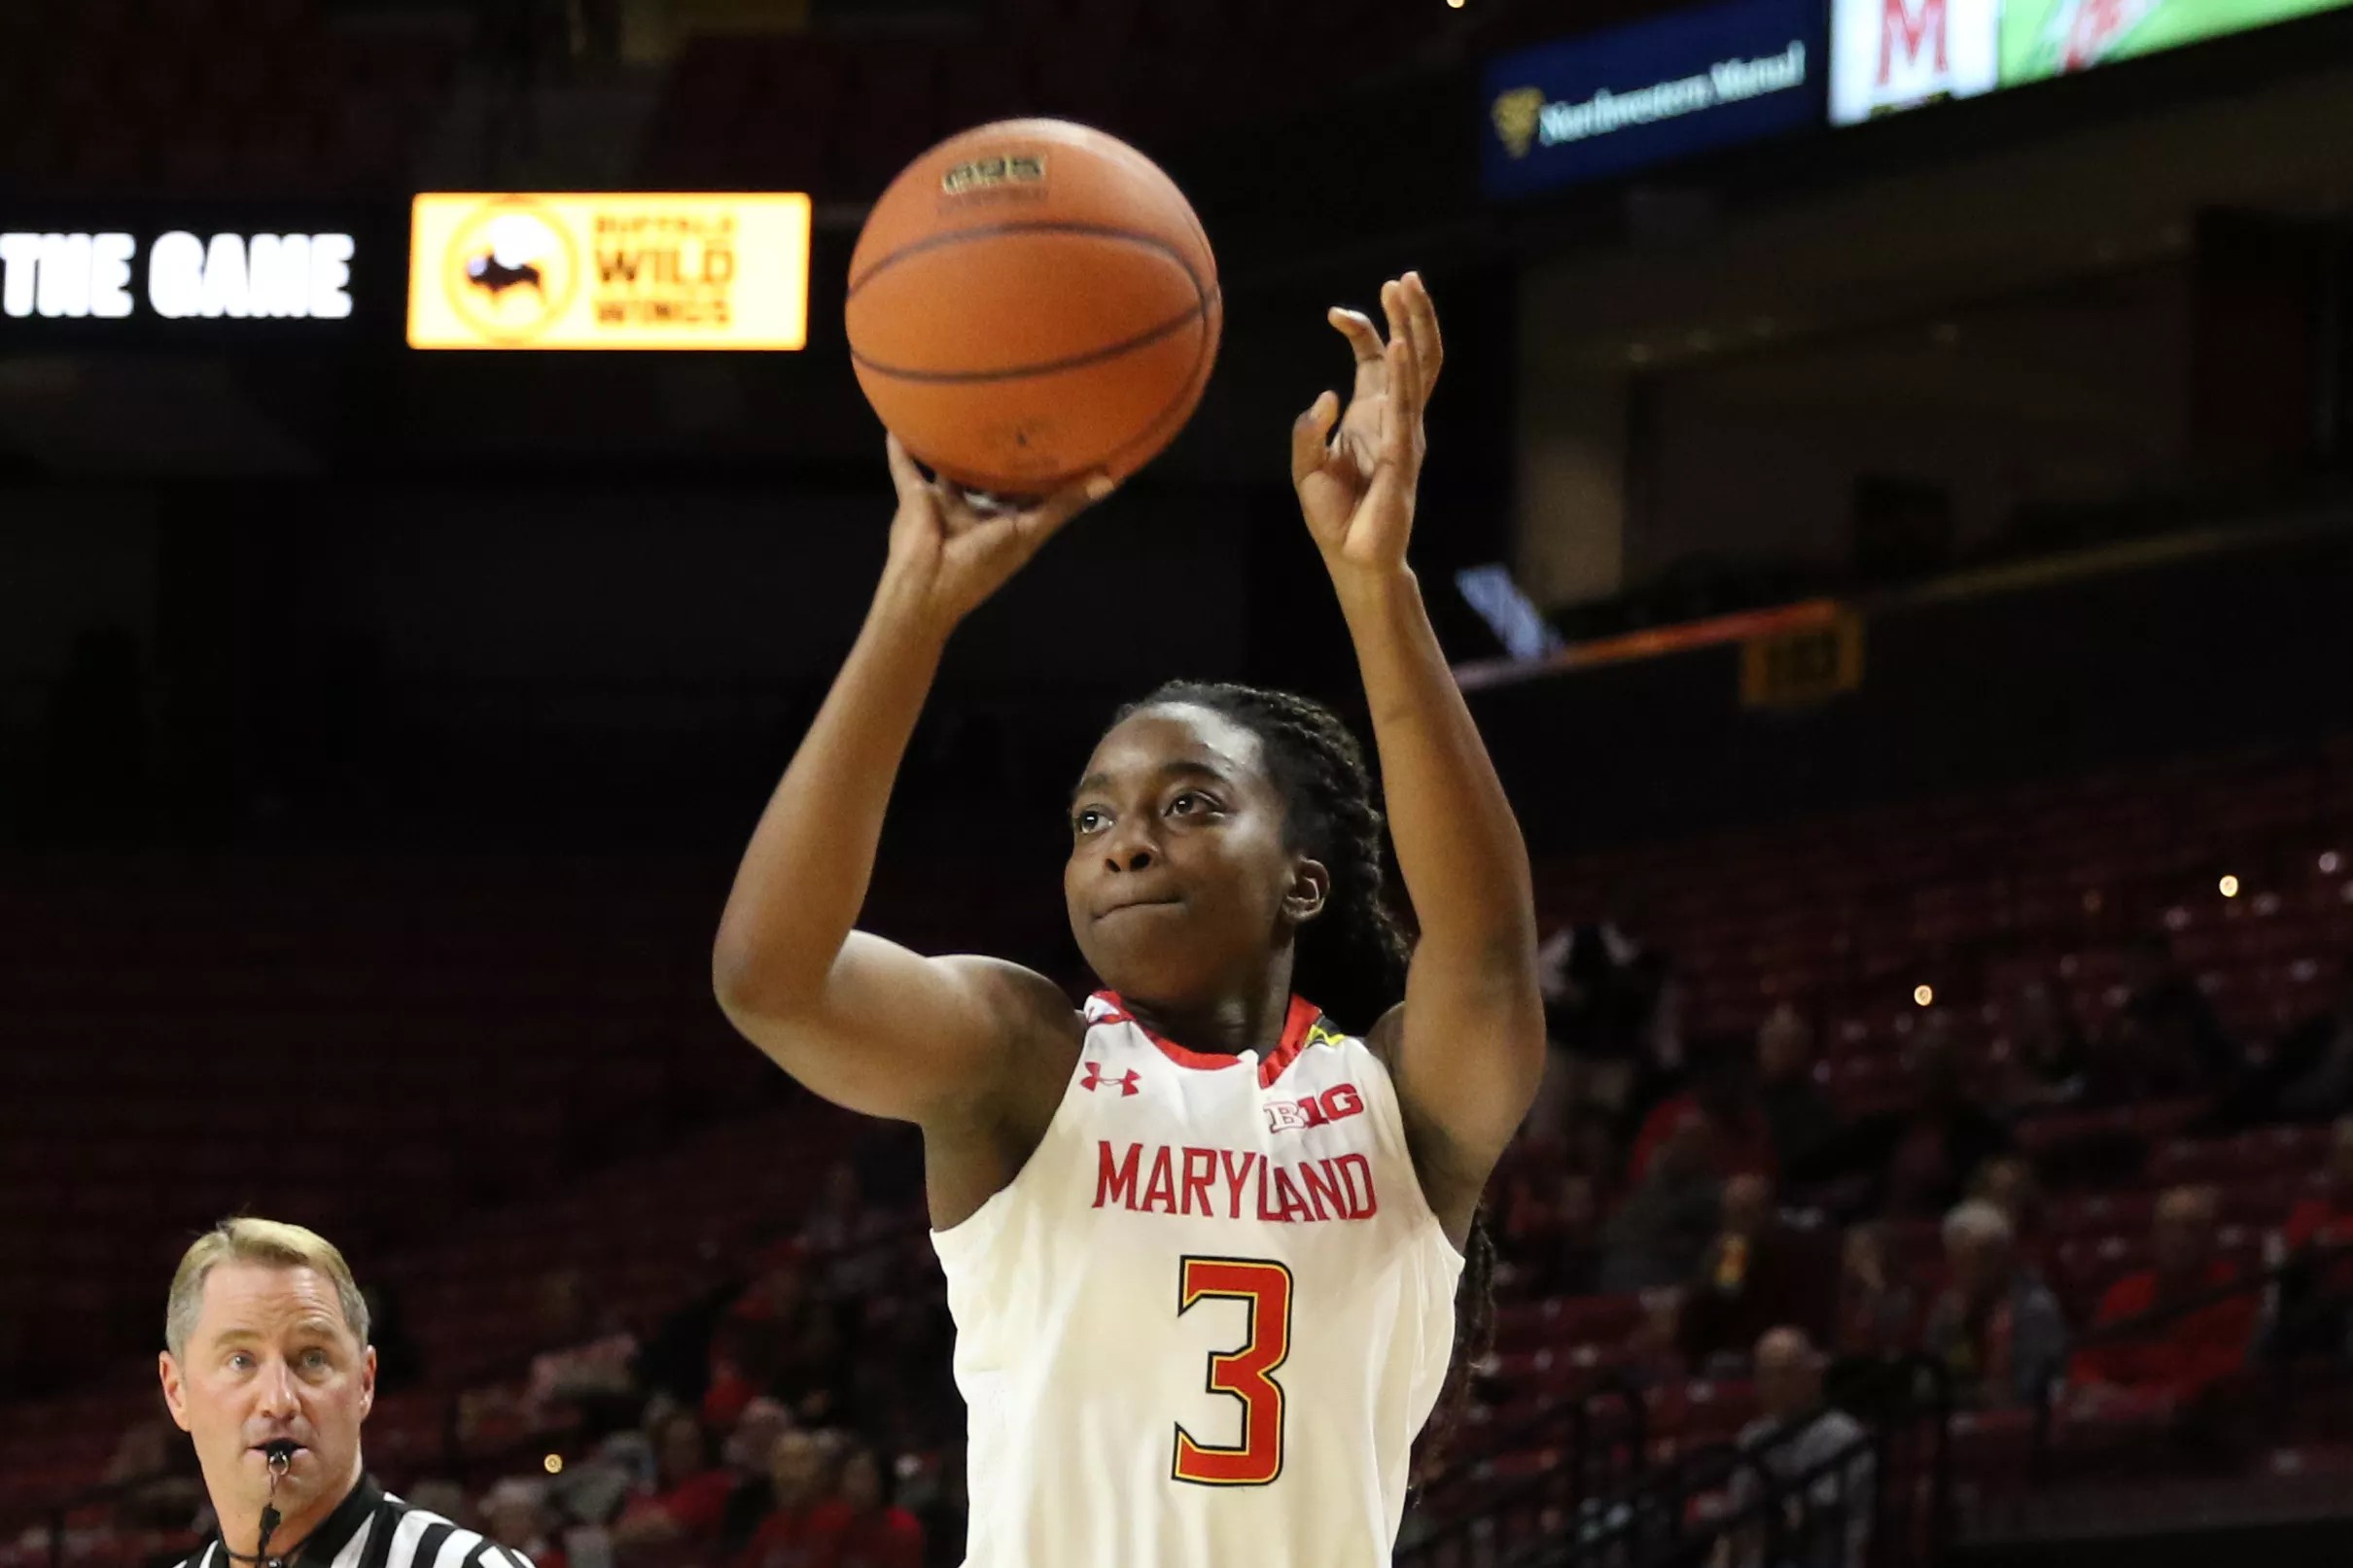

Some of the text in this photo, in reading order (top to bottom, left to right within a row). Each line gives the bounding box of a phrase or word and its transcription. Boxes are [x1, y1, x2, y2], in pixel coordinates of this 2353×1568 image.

[1539, 39, 1806, 147] Northwestern Mutual
[0, 230, 355, 318] THE GAME
[595, 246, 734, 286] WILD
[1092, 1140, 1378, 1222] MARYLAND
[1172, 1255, 1293, 1486] 3
